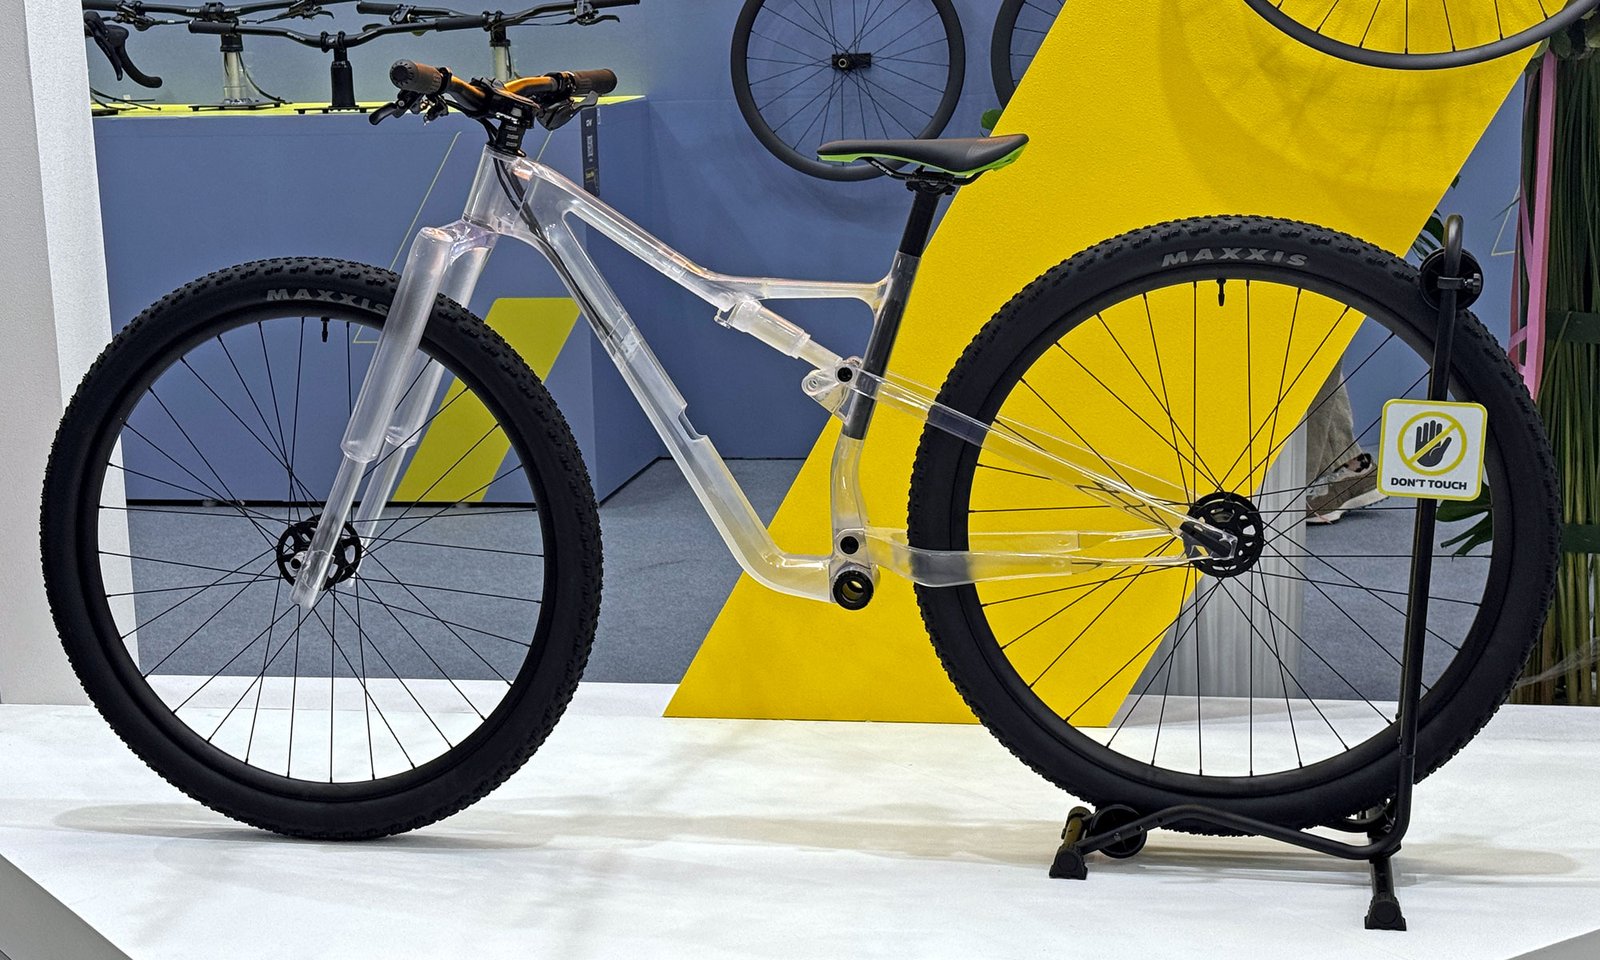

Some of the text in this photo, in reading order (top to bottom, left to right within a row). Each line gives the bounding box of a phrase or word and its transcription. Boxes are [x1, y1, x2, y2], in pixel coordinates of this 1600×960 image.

[1161, 247, 1308, 268] MAXXIS
[266, 288, 389, 317] MAXXIS
[1390, 477, 1467, 490] DON'T TOUCH
